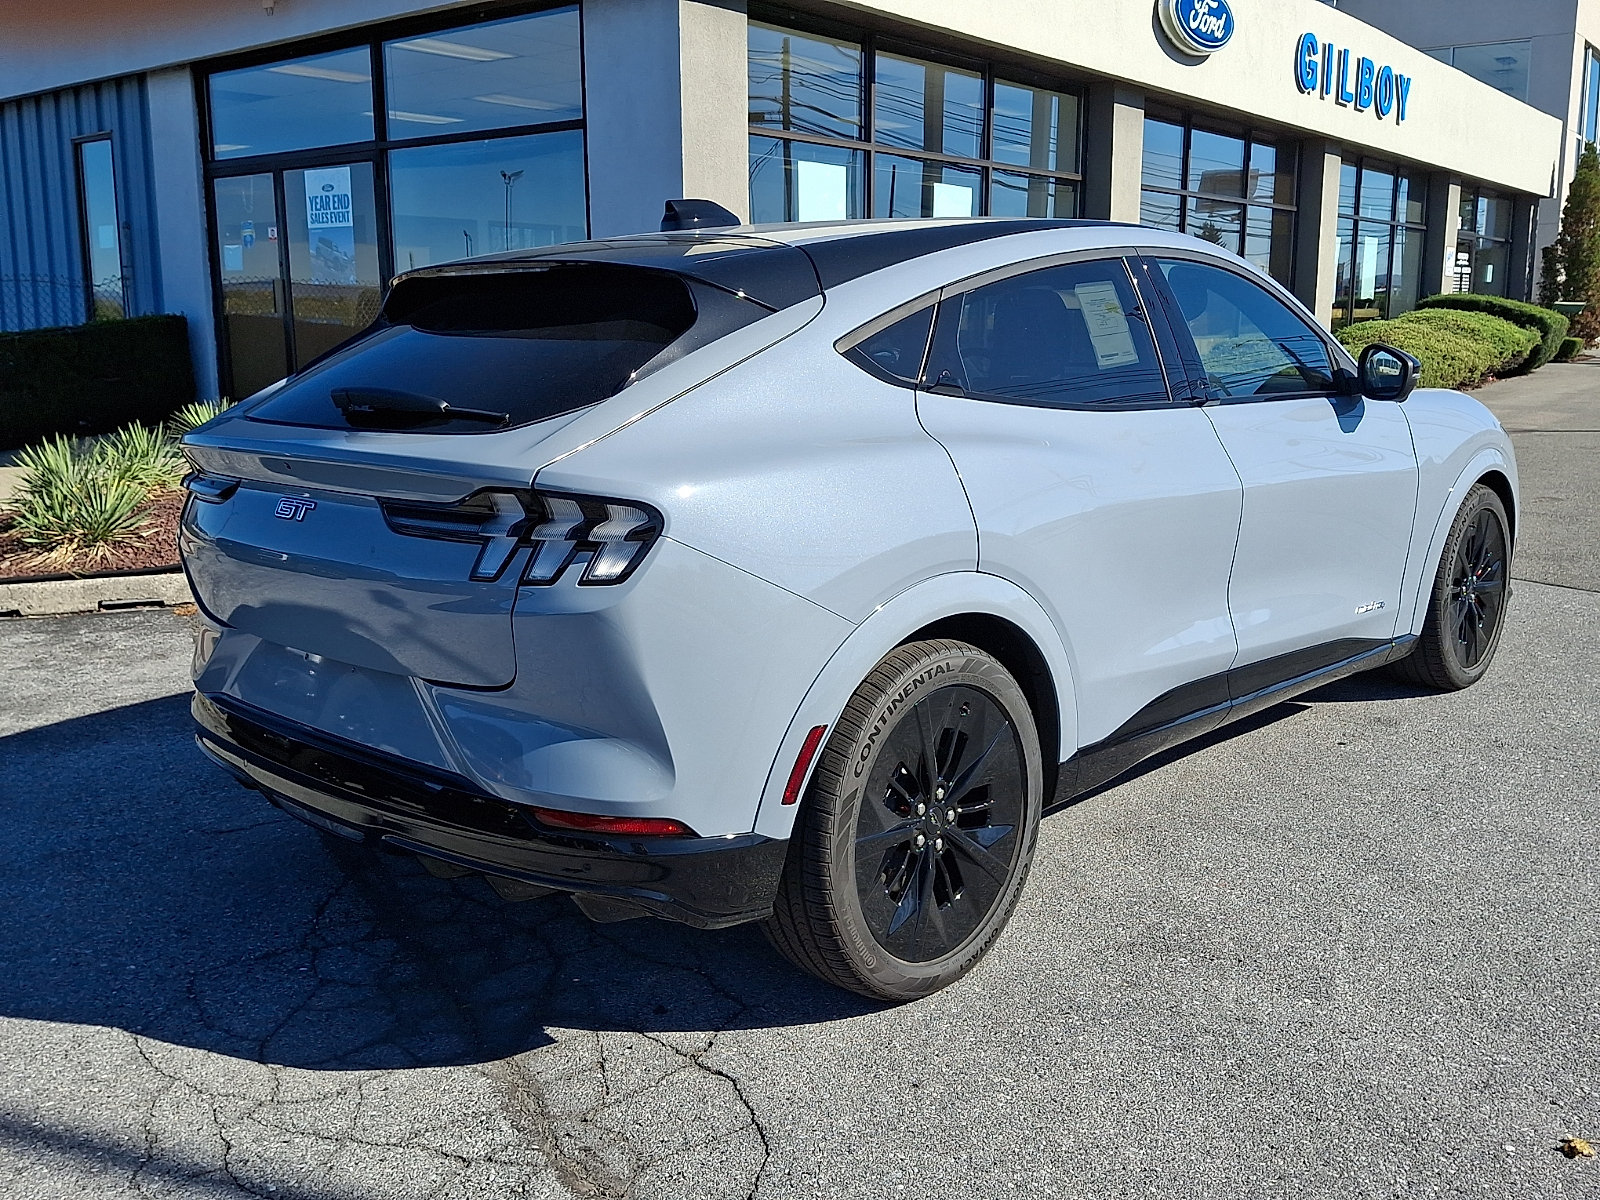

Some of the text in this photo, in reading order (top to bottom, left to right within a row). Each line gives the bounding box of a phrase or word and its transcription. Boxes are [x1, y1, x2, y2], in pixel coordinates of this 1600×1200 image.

[1189, 0, 1228, 40] Ford
[1297, 32, 1412, 121] GILBOY
[308, 193, 350, 212] YEAR END
[310, 211, 350, 225] SALES EVENT
[275, 497, 317, 522] GT
[854, 661, 956, 778] CONTINENTAL
